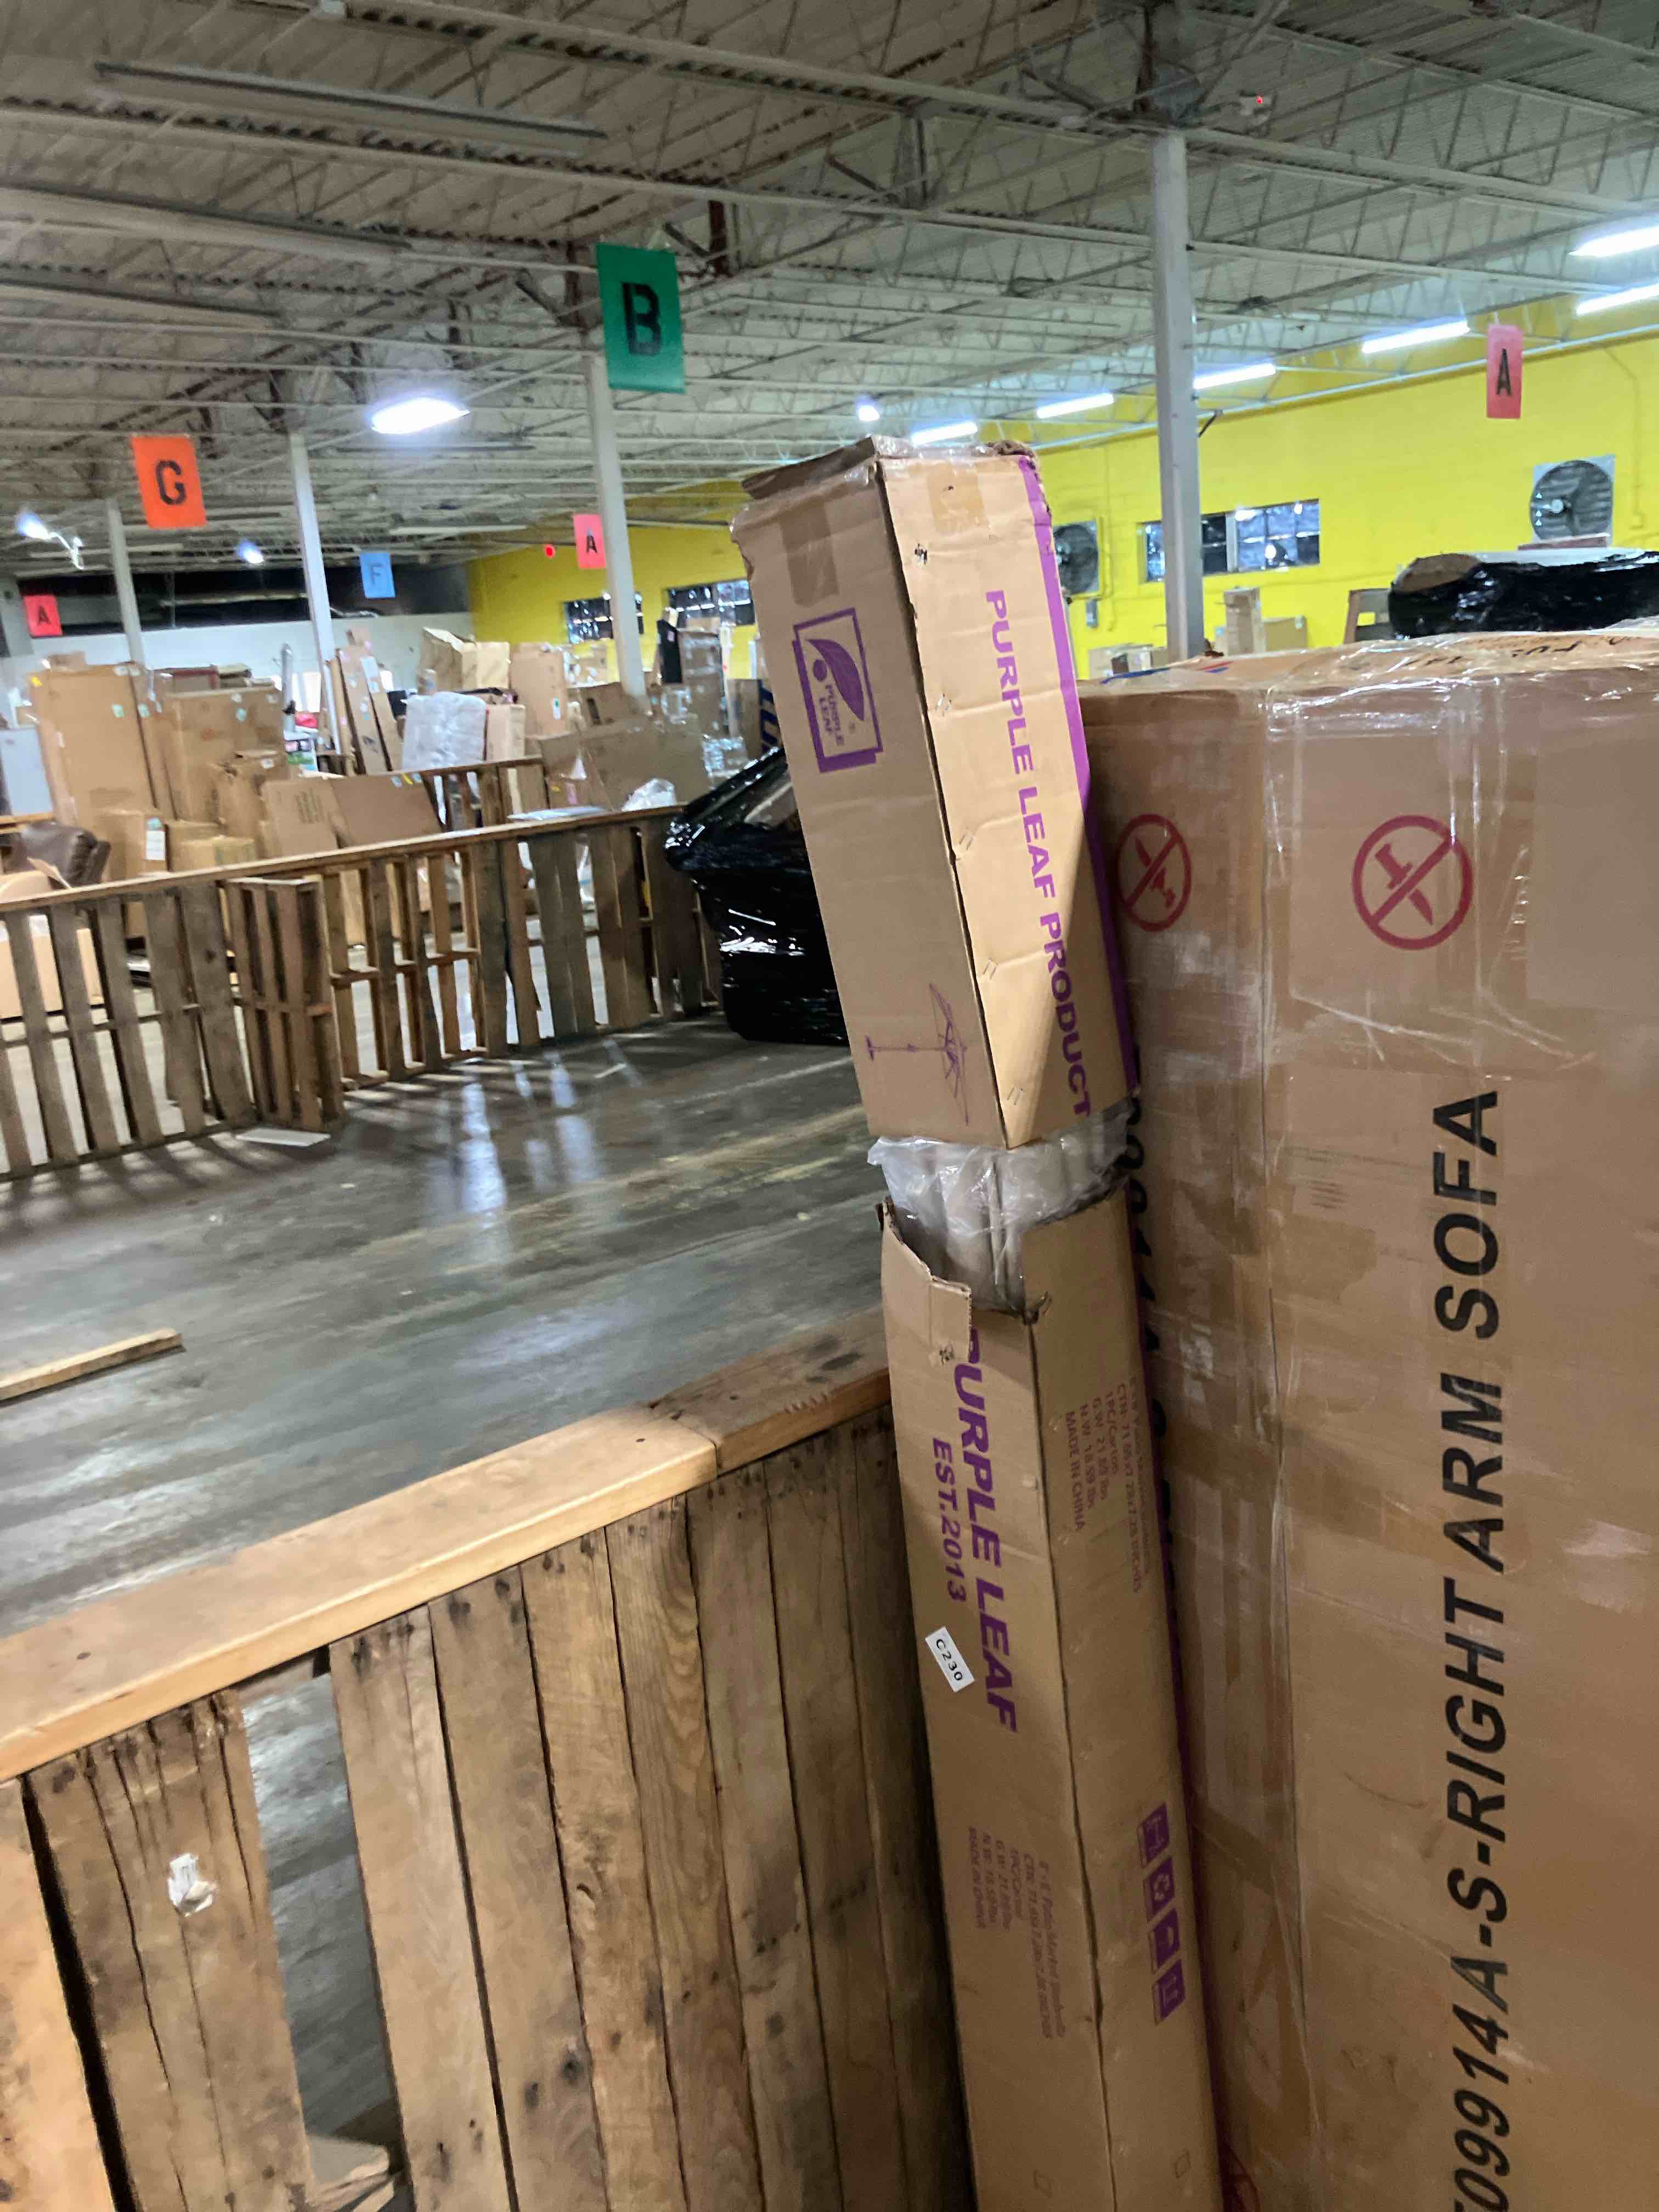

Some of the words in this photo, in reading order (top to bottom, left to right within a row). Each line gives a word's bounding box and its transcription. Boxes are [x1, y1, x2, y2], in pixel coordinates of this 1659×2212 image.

[620, 281, 662, 356] B
[1496, 348, 1513, 397] A
[154, 459, 188, 506] G
[585, 527, 598, 554] A
[369, 564, 384, 585] F
[36, 605, 52, 625] A
[819, 697, 833, 735] LEAF
[825, 684, 845, 747] PURPLE
[985, 589, 1034, 774] PURPLE
[1018, 786, 1057, 898] LEAF
[1039, 912, 1091, 1118] PRODUCT
[1432, 1090, 1500, 1340] SOFA
[1065, 1411, 1081, 1458] MADE
[1440, 1372, 1504, 1575] ARM
[933, 1437, 967, 1602] EST.2013
[1072, 1482, 1086, 1531] CHINA
[936, 1639, 963, 1681] C230
[977, 1578, 1017, 1734] LEAF
[1443, 1576, 1511, 2212] 09914A-S-RIGHT
